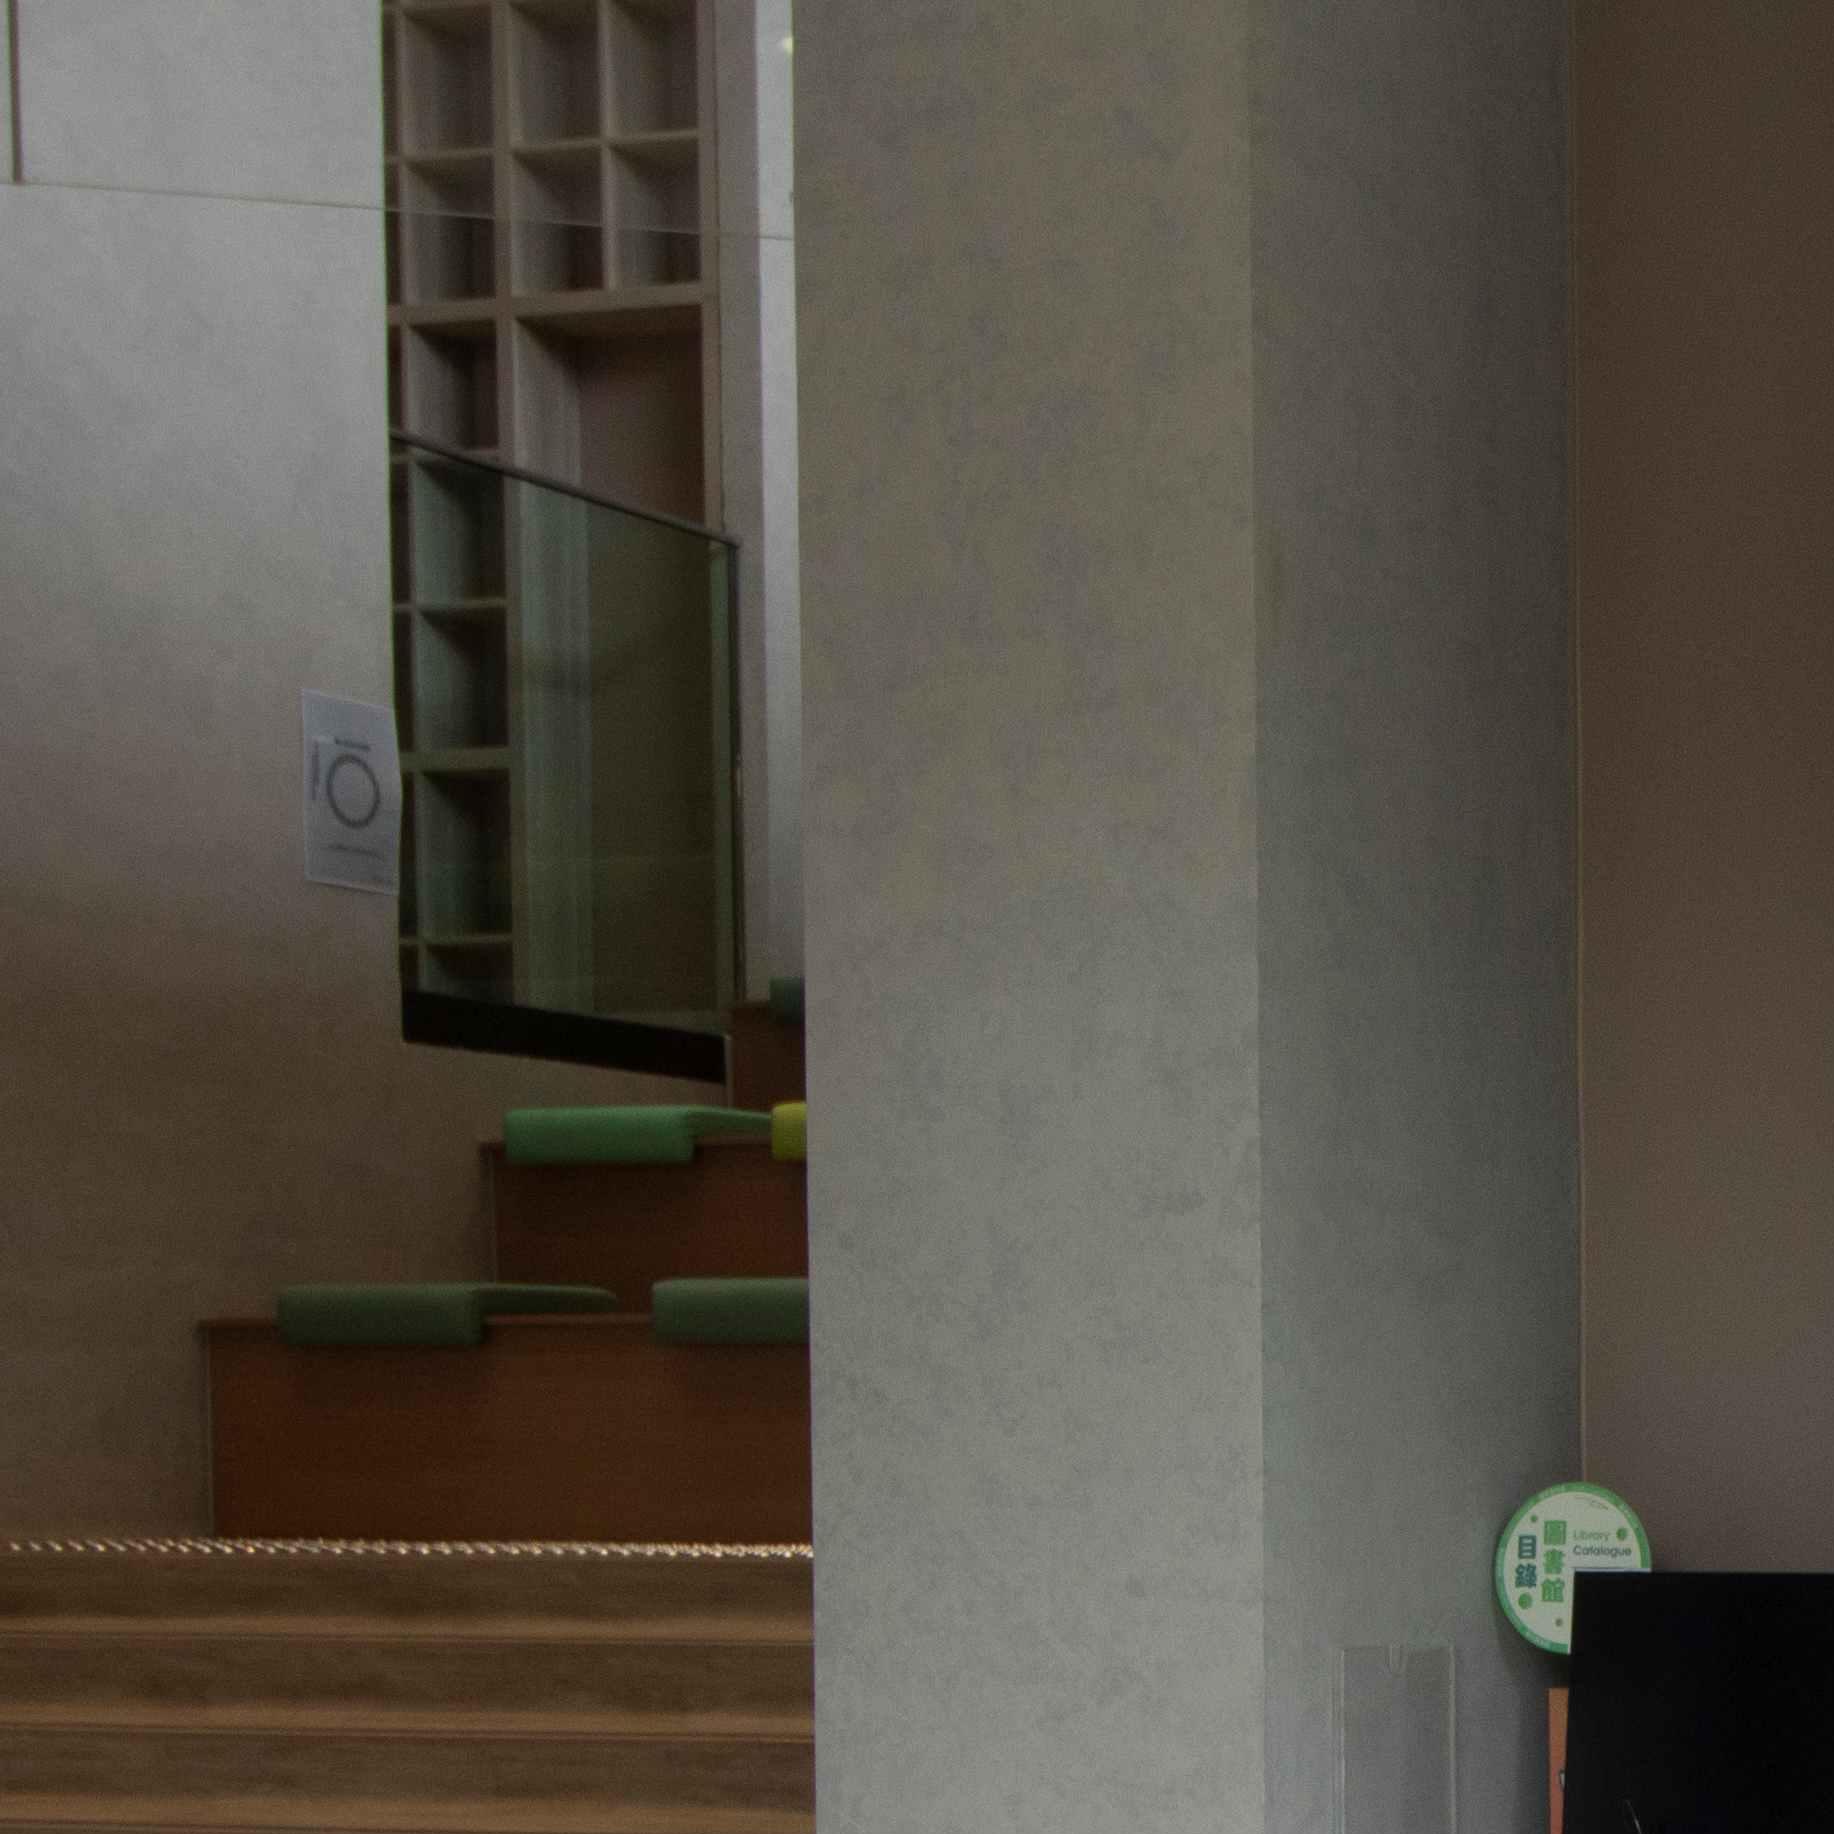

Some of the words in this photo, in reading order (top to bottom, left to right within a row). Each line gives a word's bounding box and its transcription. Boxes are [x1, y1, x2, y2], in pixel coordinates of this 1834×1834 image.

[1572, 1544, 1633, 1559] Catalogue
[1573, 1529, 1611, 1543] Library
[1514, 1534, 1537, 1588] 目錄
[1541, 1520, 1568, 1603] 圖書館
